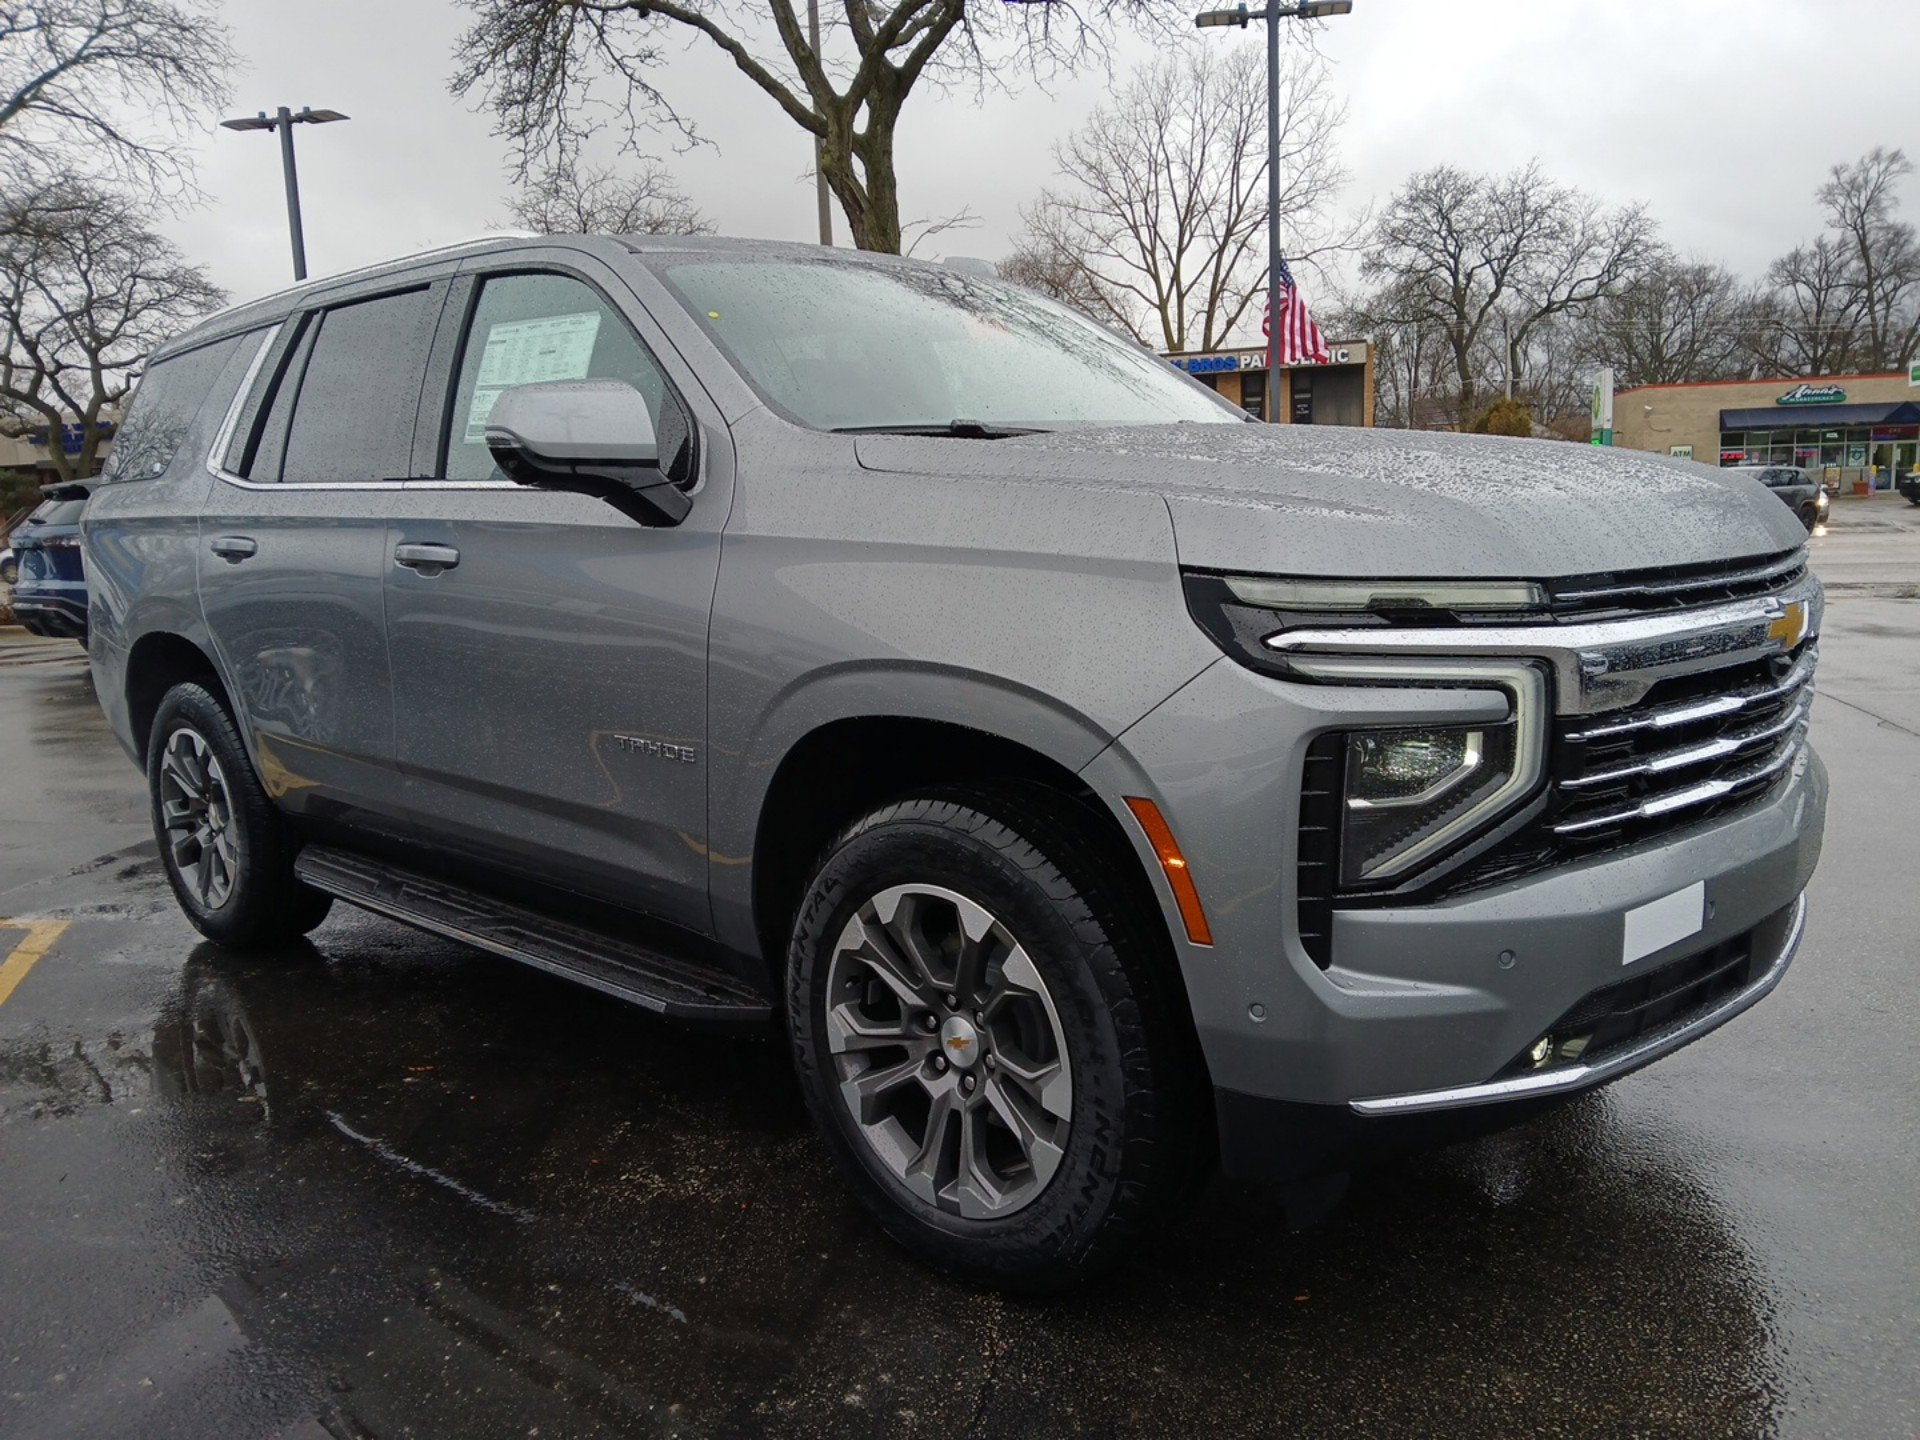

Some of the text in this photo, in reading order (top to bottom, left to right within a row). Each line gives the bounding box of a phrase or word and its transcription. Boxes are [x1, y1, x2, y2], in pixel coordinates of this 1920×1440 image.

[1188, 356, 1236, 373] BROS
[1288, 349, 1349, 365] LIIC
[613, 734, 695, 763] TAHOE
